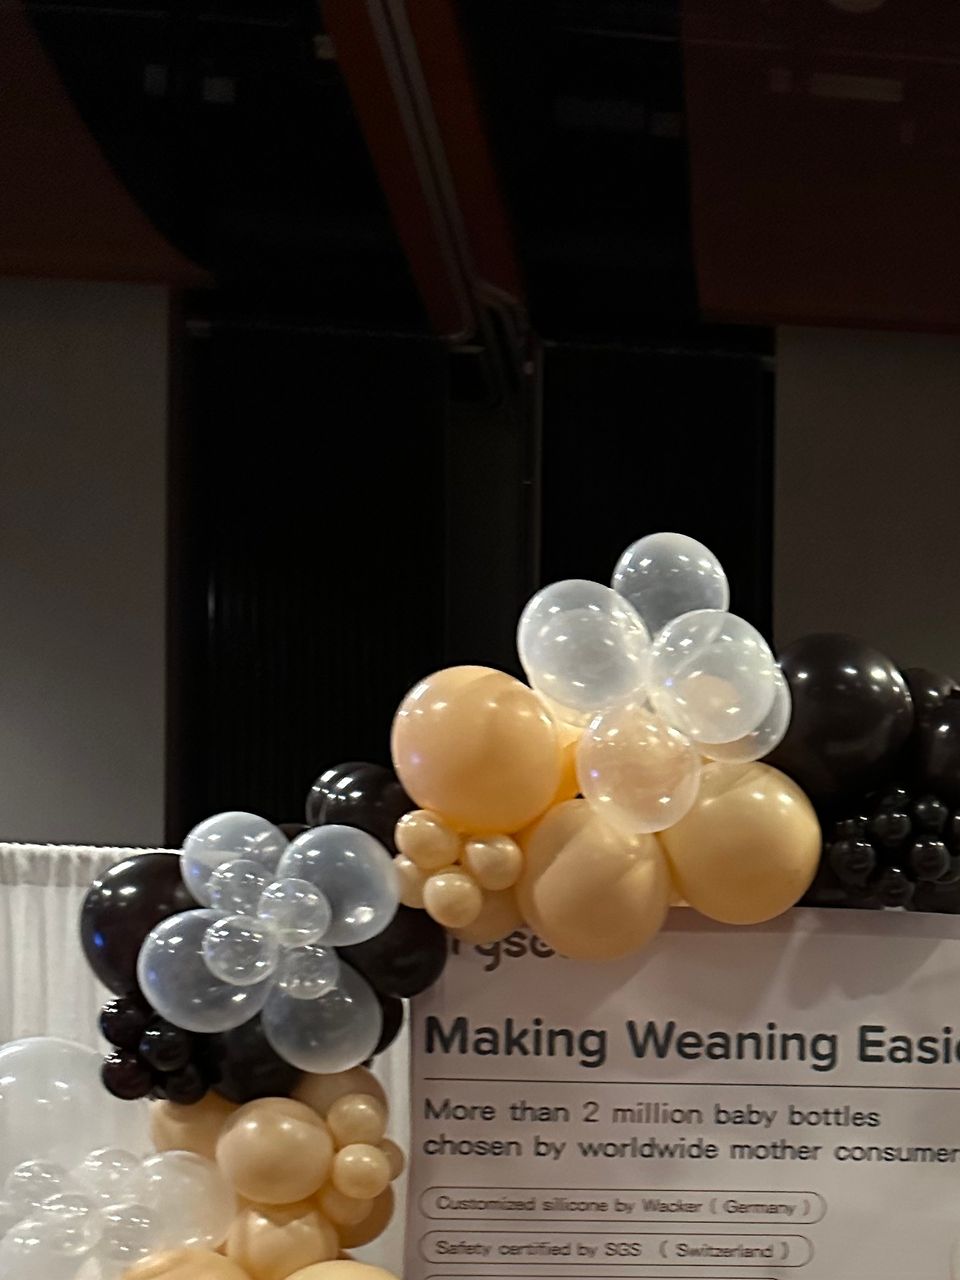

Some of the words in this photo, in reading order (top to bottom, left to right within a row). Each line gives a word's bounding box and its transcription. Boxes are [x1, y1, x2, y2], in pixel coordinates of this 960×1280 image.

[424, 1015, 608, 1069] Making
[625, 1019, 838, 1072] Weaning
[424, 1097, 496, 1121] More
[509, 1099, 570, 1122] than
[582, 1100, 600, 1123] 2
[611, 1101, 703, 1125] million
[714, 1103, 777, 1129] baby
[788, 1104, 881, 1128] bottles
[422, 1133, 522, 1157] chosen
[534, 1135, 567, 1161] by
[577, 1136, 719, 1160] worldwide
[730, 1138, 822, 1162] mother
[434, 1194, 536, 1213] Customized
[614, 1198, 634, 1214] by
[434, 1239, 492, 1258] Safety
[498, 1241, 572, 1257] certified
[577, 1242, 598, 1259] by
[603, 1242, 643, 1257] SGS
